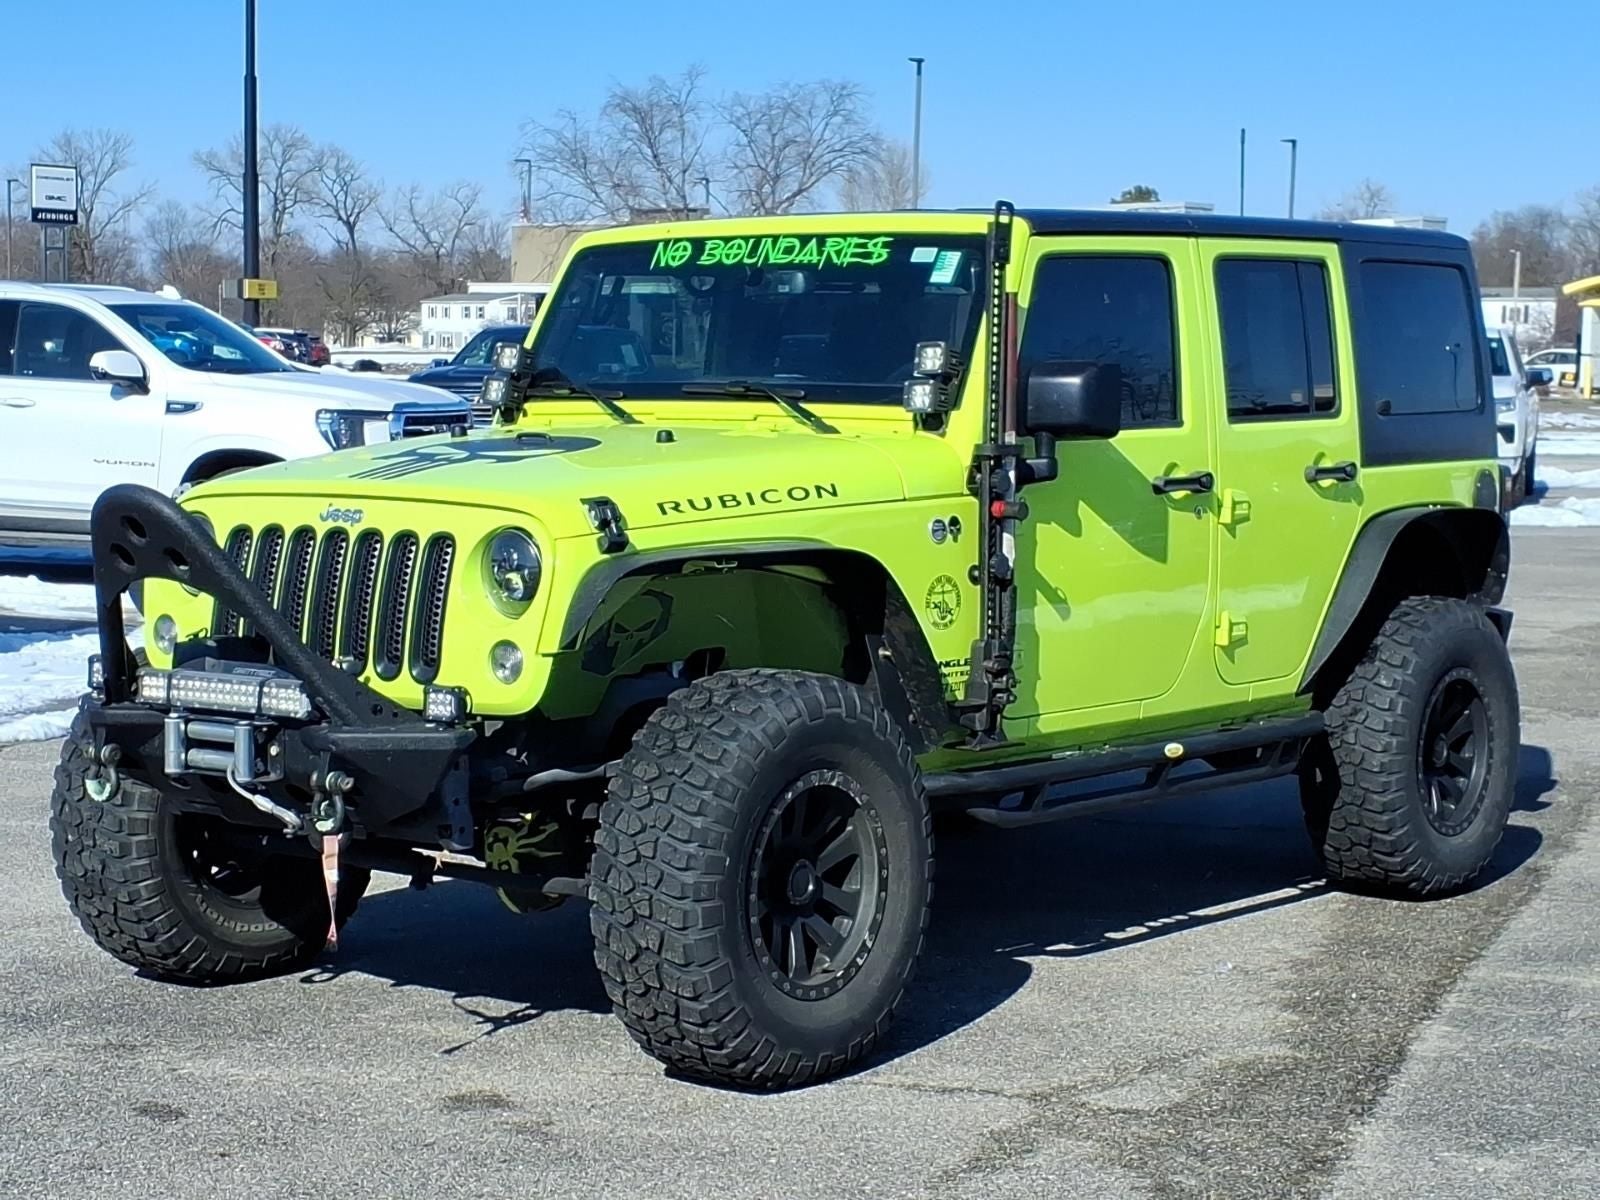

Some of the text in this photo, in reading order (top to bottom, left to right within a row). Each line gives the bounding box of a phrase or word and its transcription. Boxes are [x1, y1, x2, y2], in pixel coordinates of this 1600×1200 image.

[650, 238, 692, 270] NO
[696, 235, 895, 270] BOUNDARIES
[319, 502, 364, 527] Jeep
[656, 483, 839, 516] RUBICON
